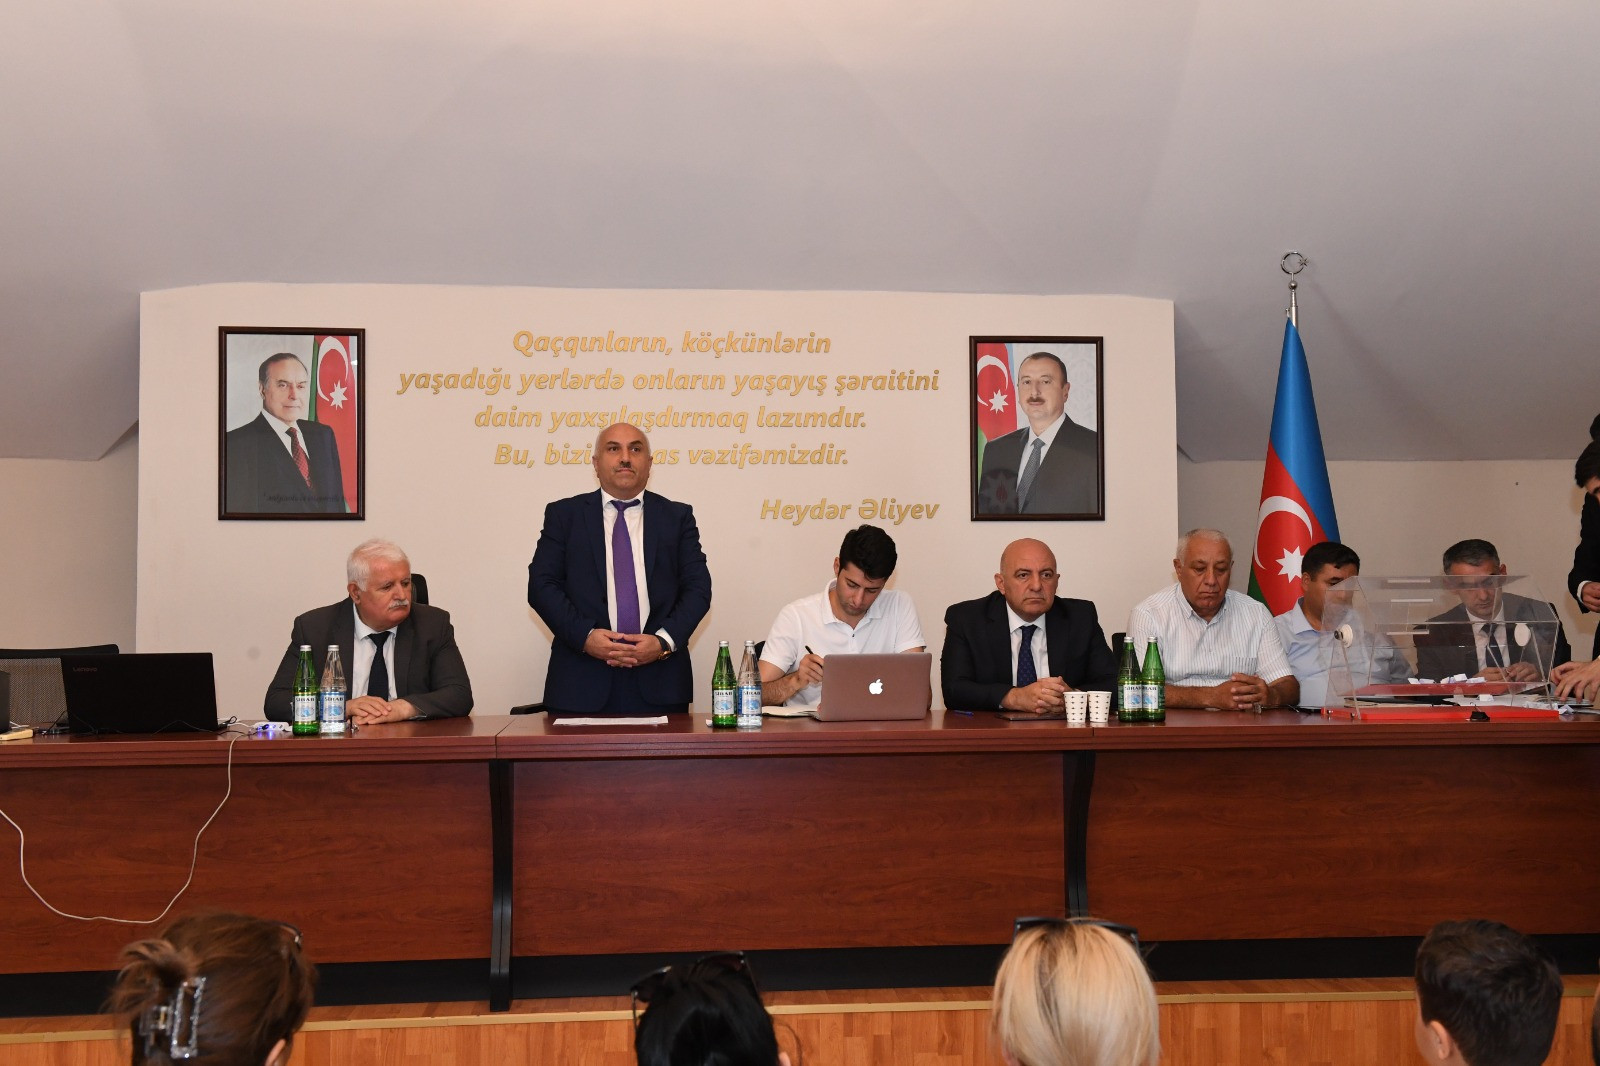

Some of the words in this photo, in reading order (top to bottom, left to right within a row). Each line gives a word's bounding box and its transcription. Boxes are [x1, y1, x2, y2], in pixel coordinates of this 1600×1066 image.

[512, 328, 673, 359] Qaçqınların,
[682, 329, 832, 359] köçkünlərin
[396, 367, 512, 397] yaşadığı
[517, 367, 625, 396] yerlərdə
[632, 367, 727, 391] onların
[731, 373, 829, 397] yaşayış
[835, 368, 940, 397] şəraitini
[474, 404, 543, 428] daim
[756, 404, 867, 429] lazımdır.
[494, 443, 535, 469] Bu,
[544, 442, 593, 465] bizi
[688, 442, 849, 470] vəzifəmizdir.
[760, 498, 852, 526] Heydər
[858, 498, 940, 526] Əliyev
